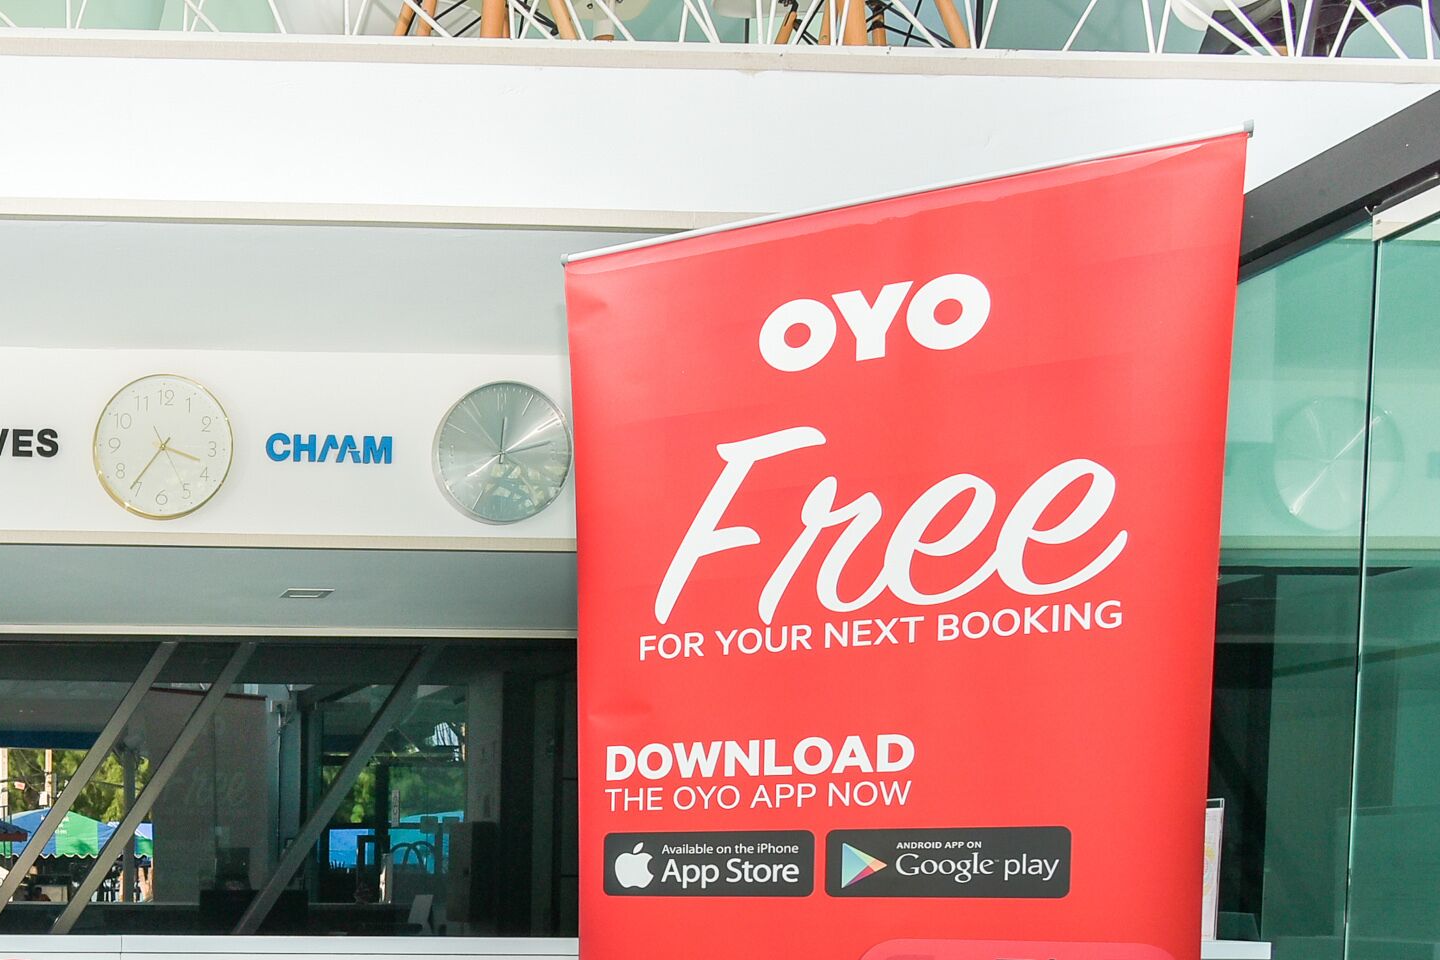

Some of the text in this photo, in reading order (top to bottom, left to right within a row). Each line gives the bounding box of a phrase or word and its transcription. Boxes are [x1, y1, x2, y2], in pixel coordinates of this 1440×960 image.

[759, 273, 991, 372] OYO
[134, 395, 149, 412] 11
[157, 389, 175, 406] 12
[185, 396, 191, 413] 1
[113, 412, 132, 429] 10
[201, 415, 211, 432] 2
[108, 437, 121, 454] 9
[207, 441, 217, 457] 3
[265, 431, 394, 465] CHAAM
[115, 462, 126, 479] 8
[199, 466, 210, 481] 4
[131, 481, 143, 497] 7
[155, 489, 168, 506] 6
[182, 482, 191, 500] 5
[655, 426, 1128, 626] Free
[640, 600, 1123, 661] FOR YOUR NEXT BOOKING
[604, 733, 915, 781] DOWNLOAD
[605, 780, 912, 812] THE OYO APP NOW
[661, 843, 799, 854] Available on the iPhone
[944, 841, 964, 849] APP
[967, 841, 982, 849] ON
[661, 858, 800, 889] App Store
[1004, 853, 1059, 881] play
